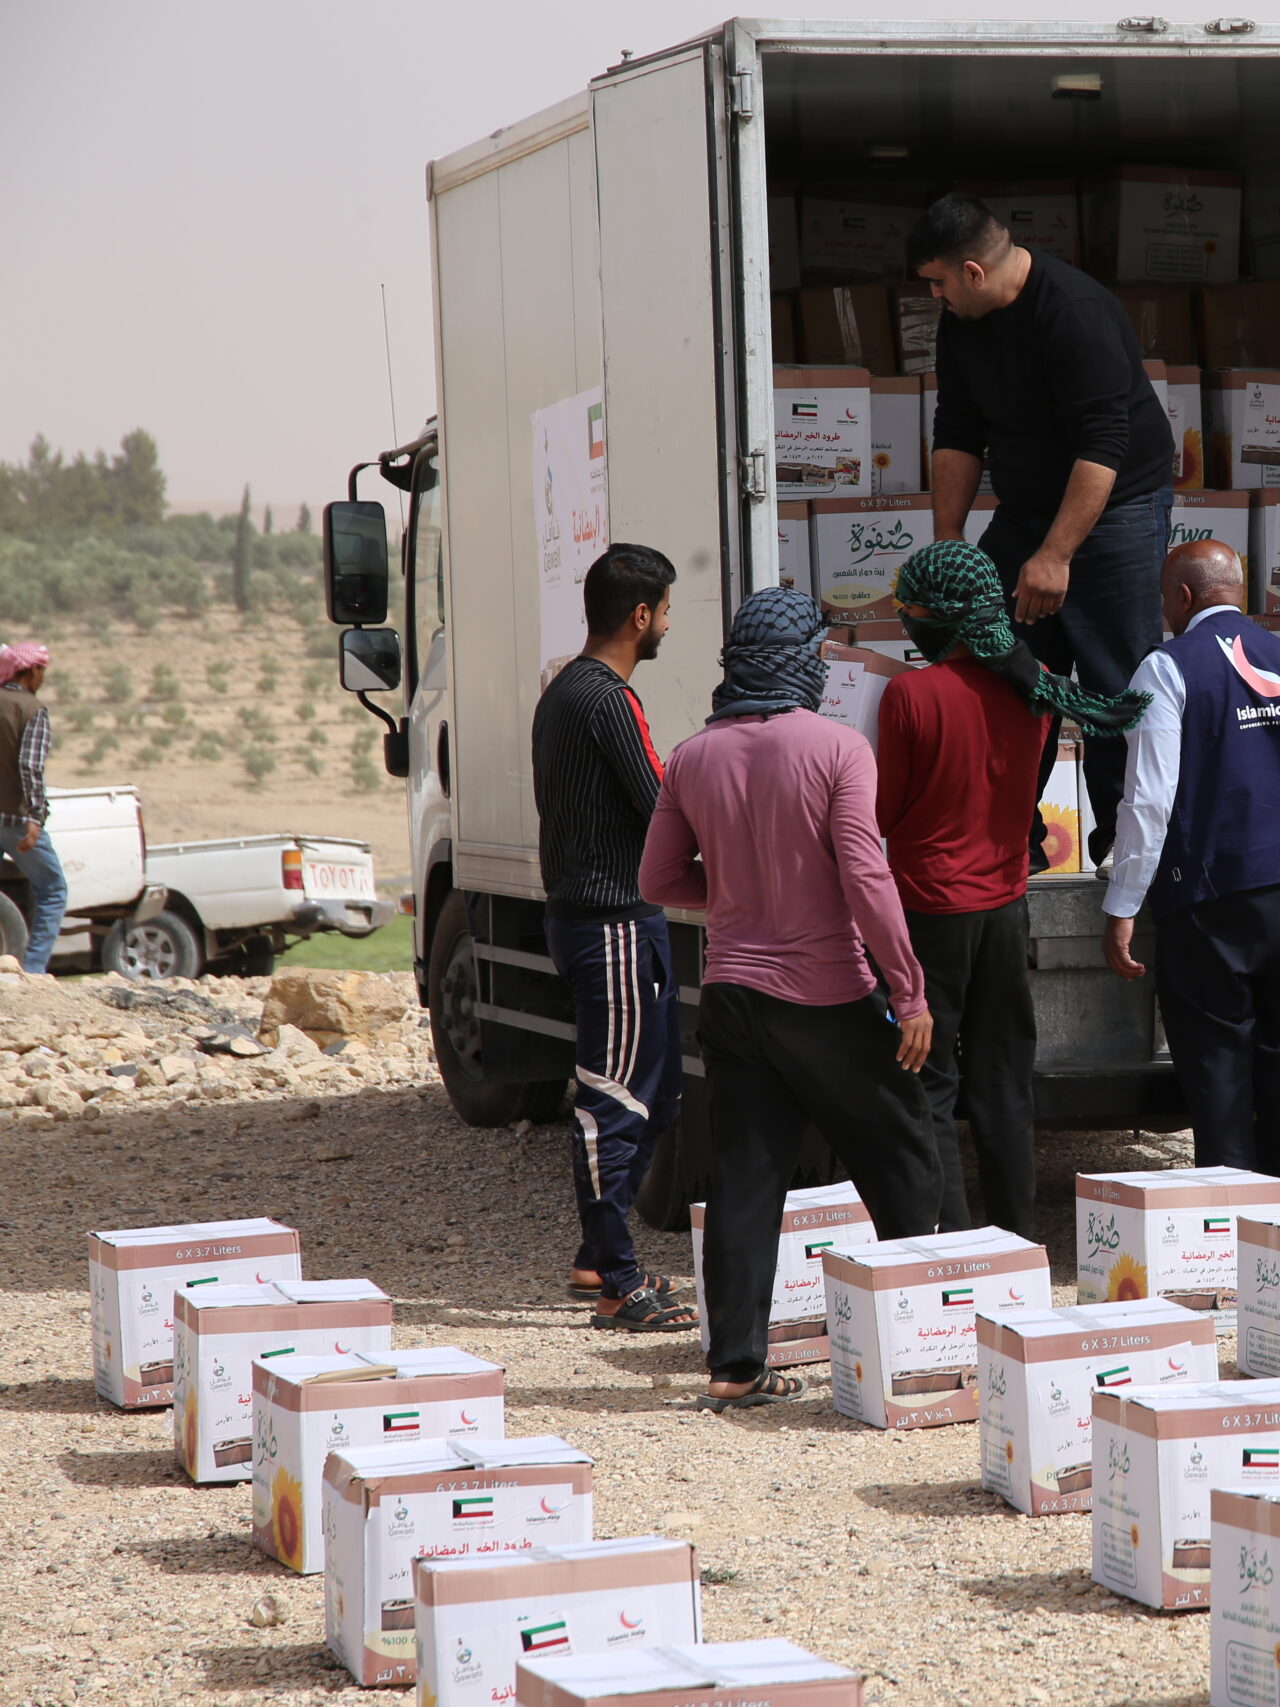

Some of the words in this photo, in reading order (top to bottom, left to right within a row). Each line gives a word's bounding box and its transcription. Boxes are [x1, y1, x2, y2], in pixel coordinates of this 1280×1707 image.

[1169, 523, 1213, 545] fwa
[309, 864, 368, 892] TOYOTA
[794, 1215, 799, 1225] 6
[811, 1213, 823, 1223] 3.7
[826, 1210, 851, 1220] Liters
[176, 1250, 182, 1258] 6
[196, 1248, 210, 1257] 3.7
[214, 1245, 241, 1255] Liters
[928, 1269, 934, 1277] 6
[947, 1266, 960, 1274] 3.7
[964, 1261, 990, 1272] Liters
[1082, 1341, 1088, 1351] 6
[1092, 1340, 1099, 1349] X
[1102, 1337, 1117, 1348] 3.7
[1121, 1334, 1150, 1346] Liters
[1223, 1416, 1229, 1427] 6
[1233, 1416, 1241, 1426] X
[1245, 1415, 1261, 1426] 3.7
